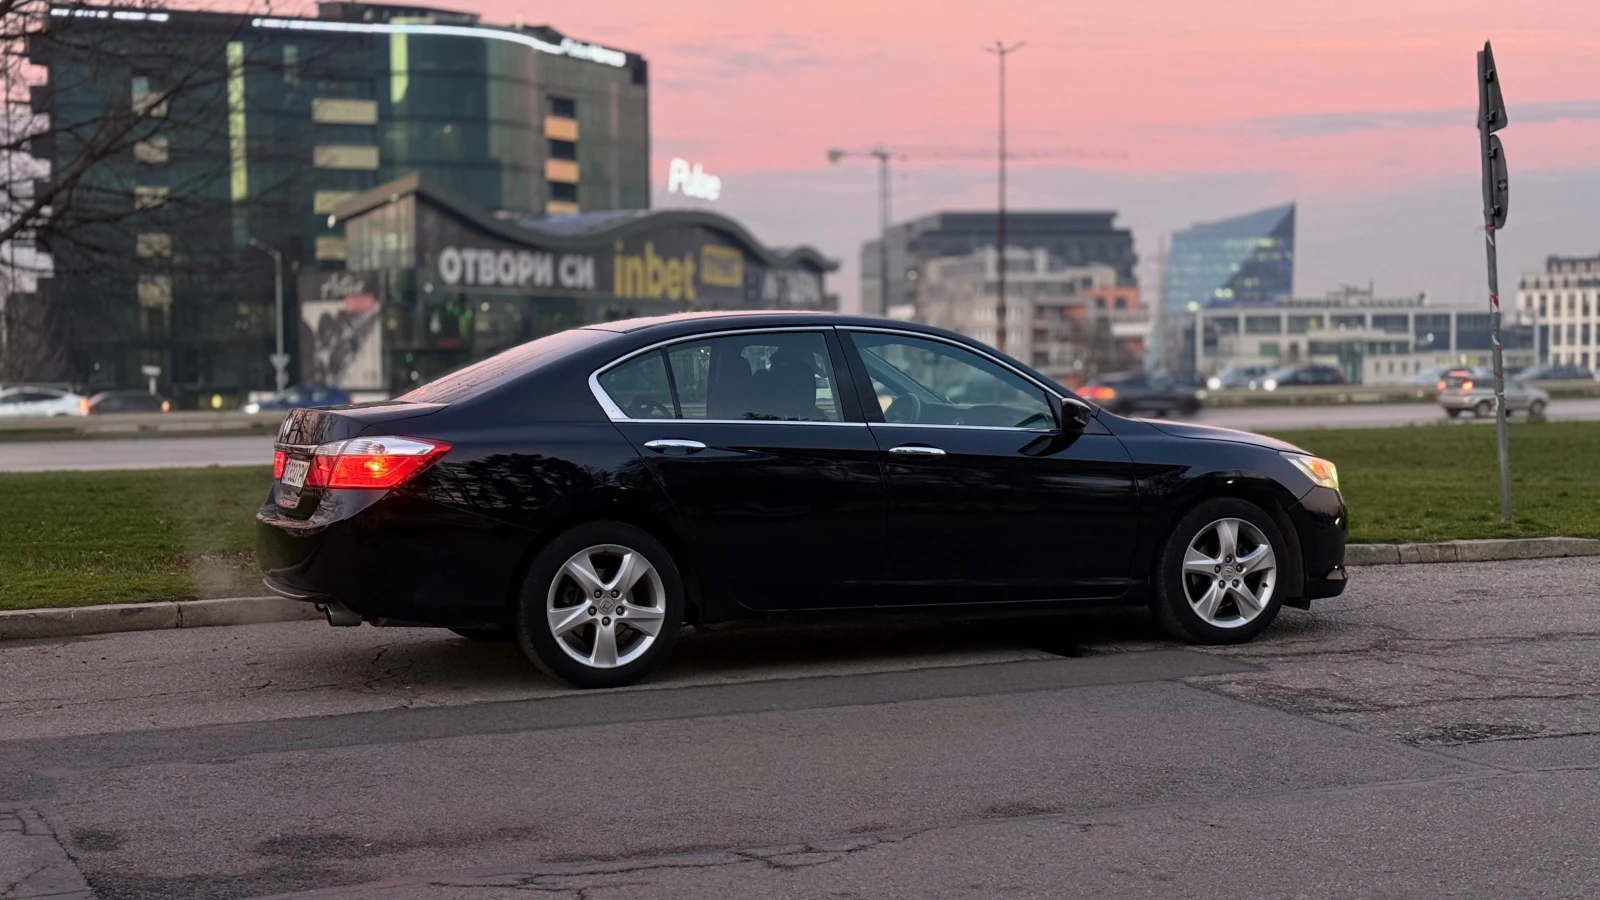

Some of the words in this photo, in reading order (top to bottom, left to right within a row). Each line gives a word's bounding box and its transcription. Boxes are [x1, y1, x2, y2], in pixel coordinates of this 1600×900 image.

[438, 246, 554, 287] ОТВОРИ
[559, 253, 595, 289] СИ
[613, 240, 697, 299] inbet
